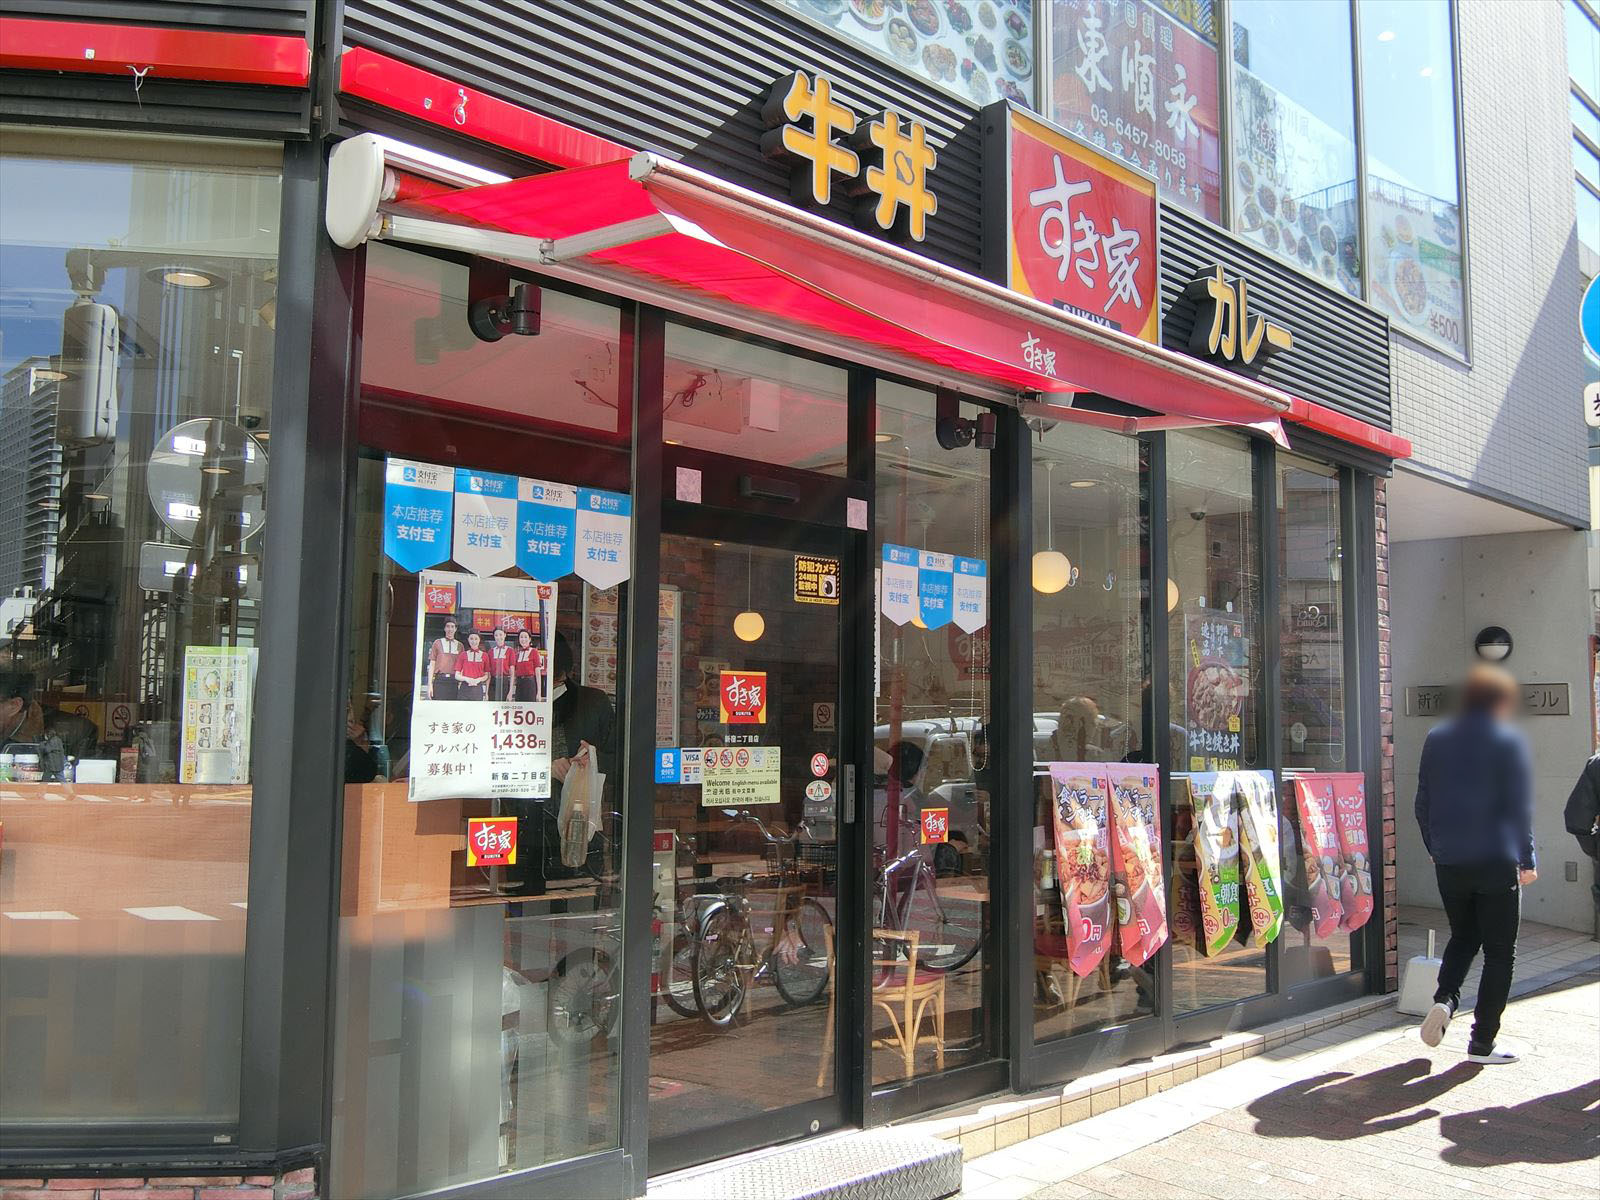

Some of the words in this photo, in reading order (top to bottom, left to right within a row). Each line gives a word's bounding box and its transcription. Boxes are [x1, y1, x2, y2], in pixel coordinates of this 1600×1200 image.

[1075, 2, 1200, 141] 東順永
[1090, 103, 1186, 170] 03-6457-8058
[783, 69, 938, 242] 牛丼
[1029, 153, 1142, 312] すき家
[1062, 304, 1112, 329] SUKIYA
[1207, 263, 1294, 365] カレー
[1430, 308, 1459, 345] ¥500
[1021, 331, 1057, 376] すき家
[417, 469, 438, 481] 支付宝
[483, 478, 504, 490] 支付宝
[545, 488, 563, 500] 支付宝
[601, 497, 619, 508] 支付宝
[391, 504, 443, 525] 本店推荐
[462, 513, 509, 531] 本店推荐
[397, 525, 436, 543] 支付宝
[522, 520, 568, 540] 本店推荐
[582, 529, 624, 547] 本店推荐
[467, 532, 503, 549] 支付宝
[527, 539, 561, 556] 支付宝
[587, 547, 619, 563] 支付宝
[798, 560, 837, 575] 防犯カメラ
[888, 592, 910, 604] 支付宝
[924, 597, 945, 609] 支付宝
[960, 601, 980, 613] 支付宝
[726, 675, 762, 711] すき家
[492, 710, 545, 727] 1,150円
[428, 721, 477, 735] すき家の
[491, 733, 547, 751] 1,438円
[724, 734, 760, 744] 新宿二丁目店
[1189, 727, 1241, 755] 牛すき焼き丼
[423, 742, 479, 756] アルバイト
[685, 754, 700, 762] VISA
[427, 762, 474, 777] 募集中!
[491, 771, 547, 781] 新宿二丁目店
[706, 779, 731, 788] Welcome
[1337, 795, 1363, 810] ベーコン
[924, 811, 946, 833] すき家
[474, 822, 513, 853] すき家
